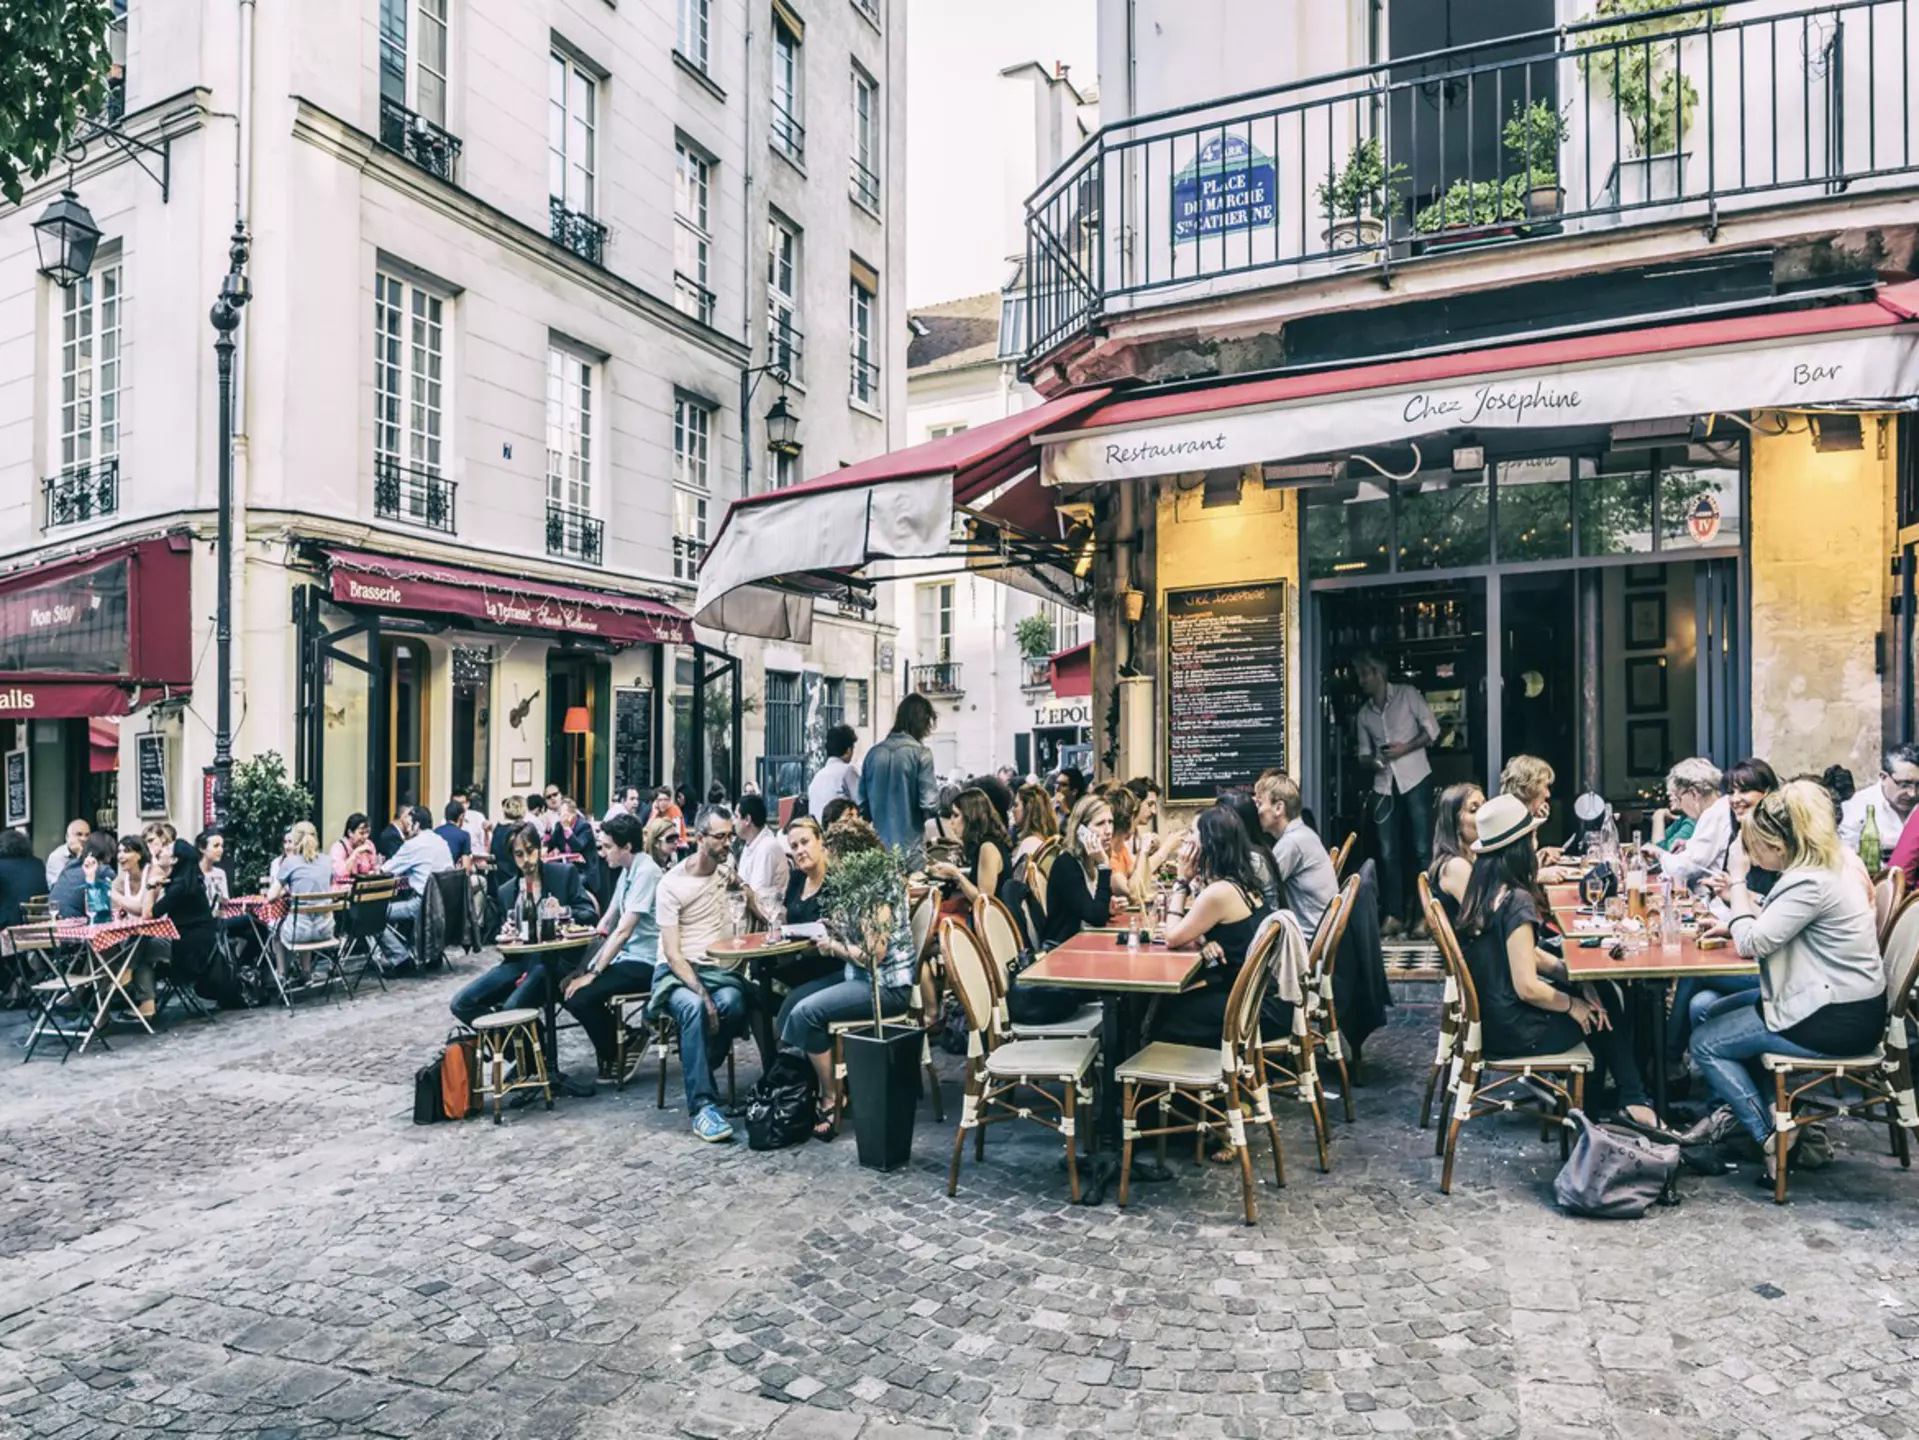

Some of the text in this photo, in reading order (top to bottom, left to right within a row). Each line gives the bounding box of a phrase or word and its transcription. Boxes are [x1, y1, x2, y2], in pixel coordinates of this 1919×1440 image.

[1194, 204, 1273, 231] CATHERNE
[1793, 364, 1843, 385] Bar
[1403, 394, 1462, 422] Chez
[1106, 433, 1226, 465] Restaurant
[350, 580, 401, 604] Brasserie
